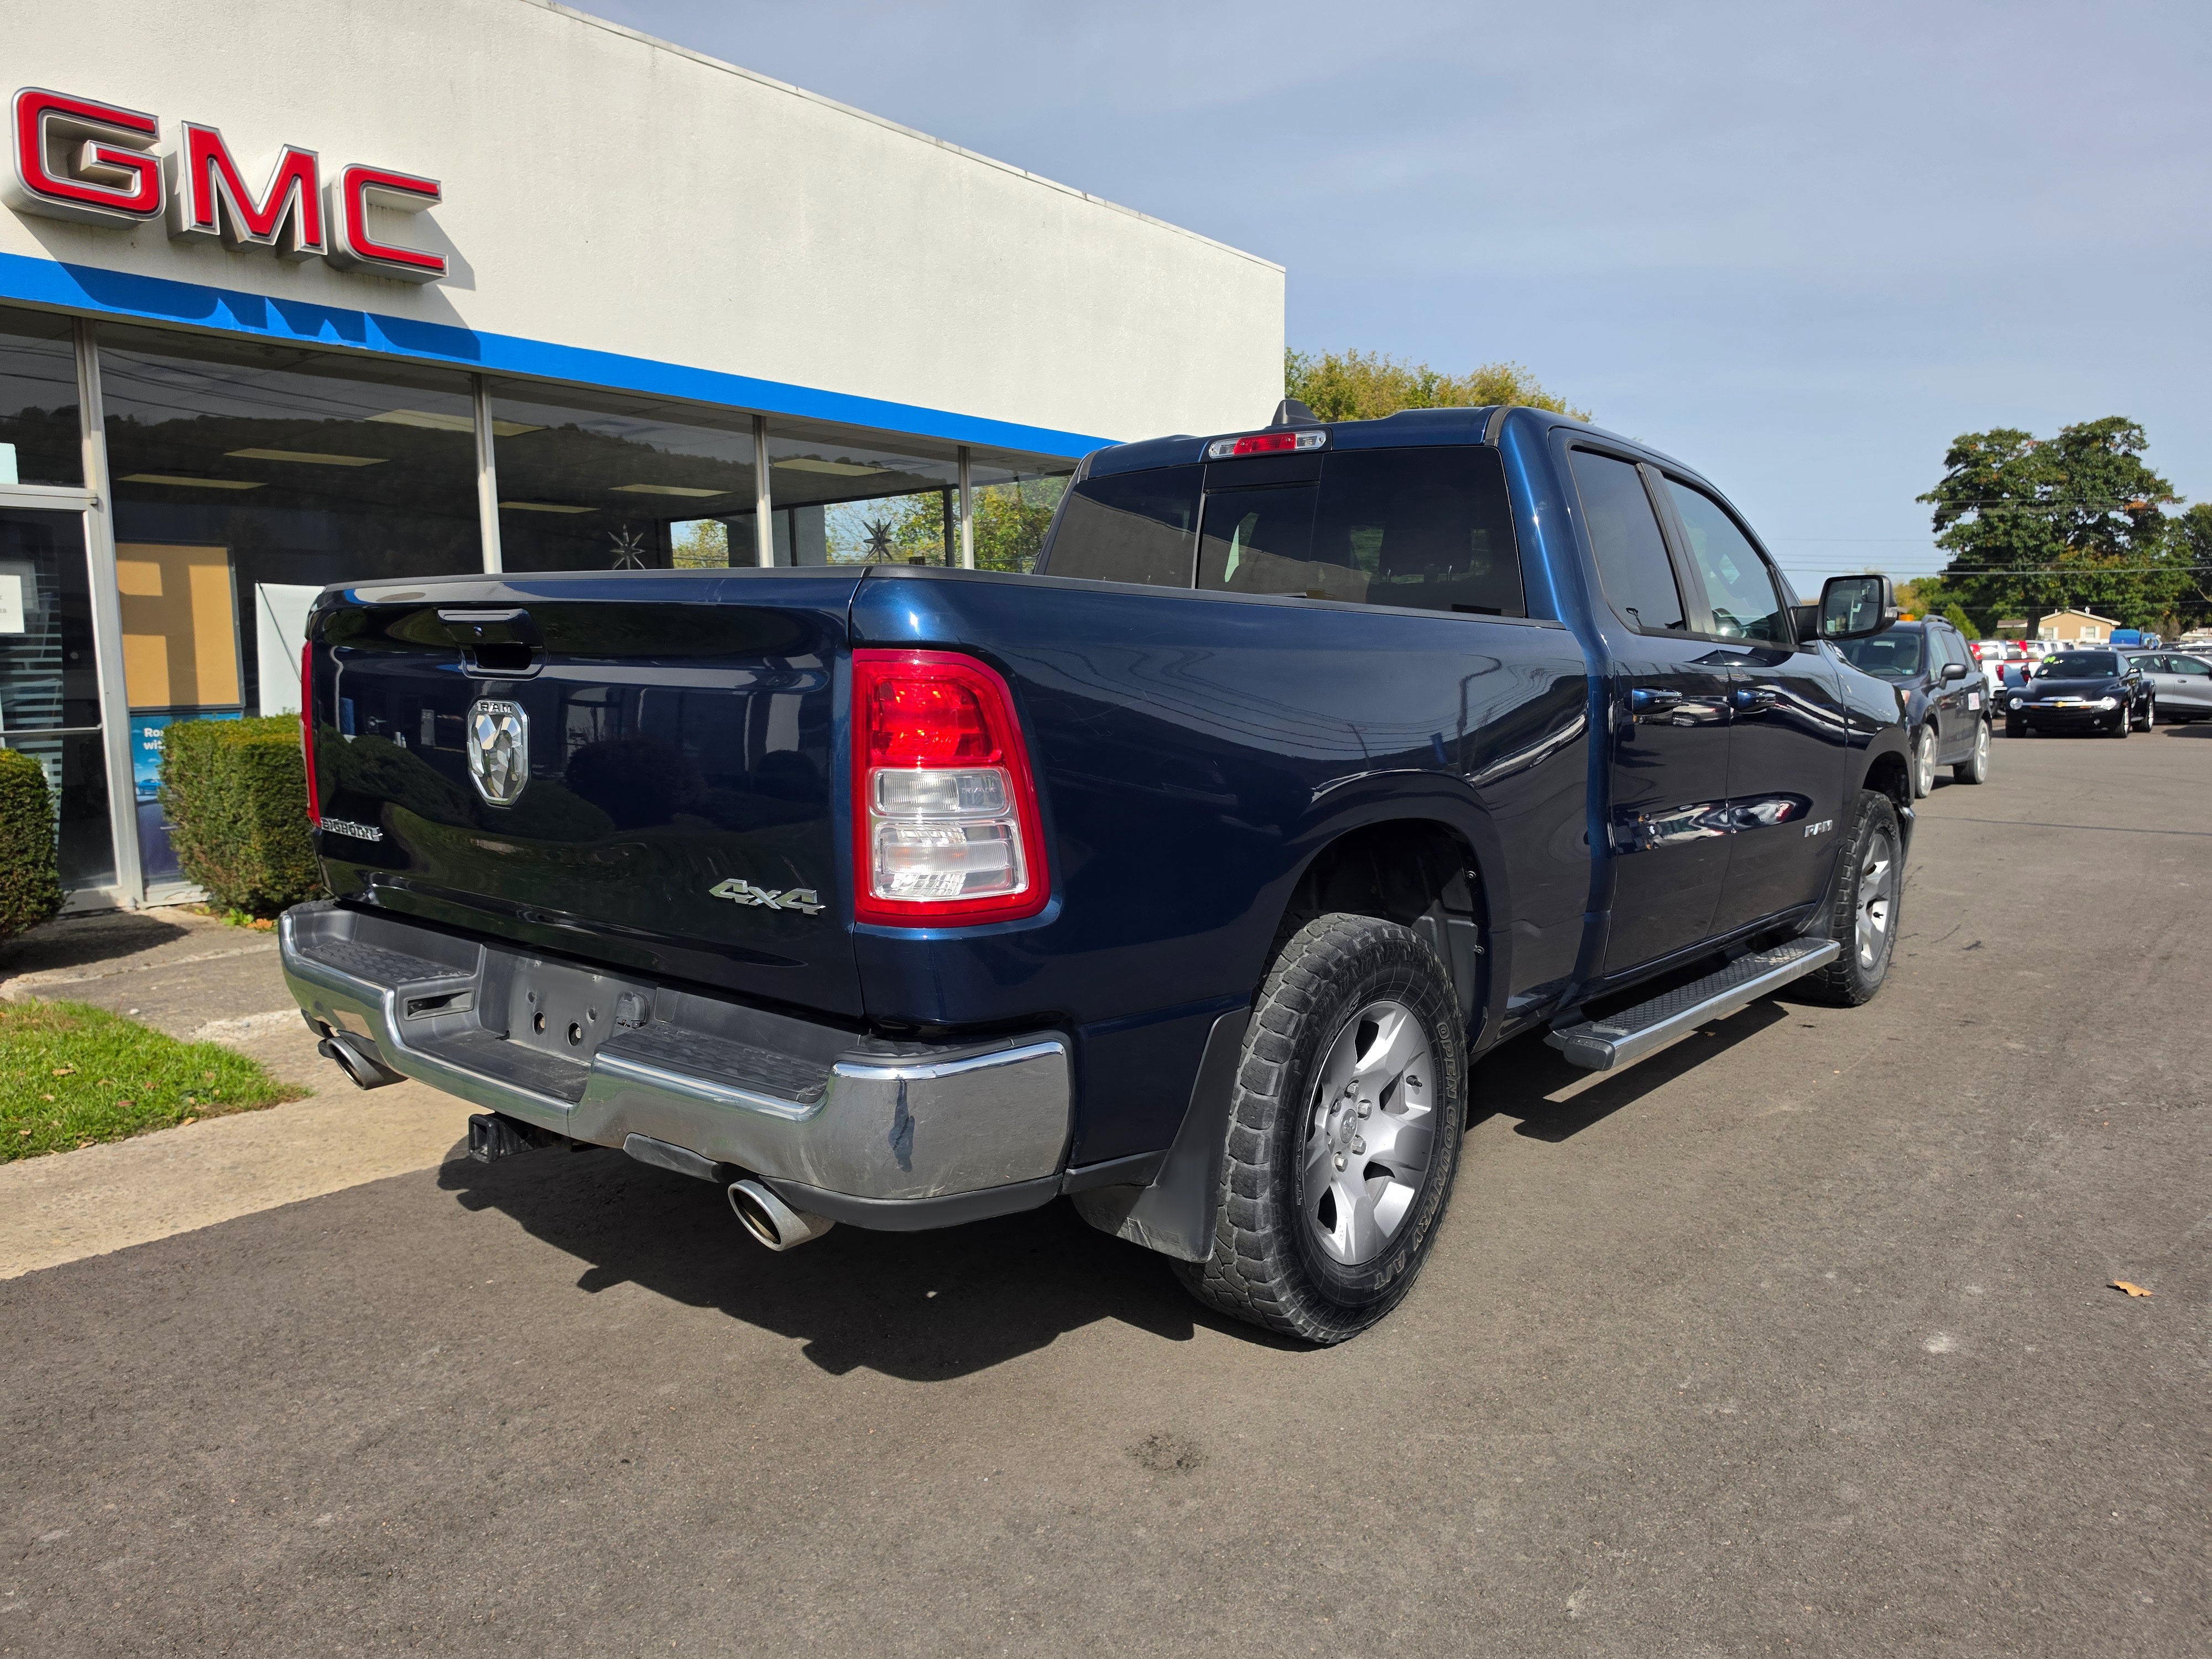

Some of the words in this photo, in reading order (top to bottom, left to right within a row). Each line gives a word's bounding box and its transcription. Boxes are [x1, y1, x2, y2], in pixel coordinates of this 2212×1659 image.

[10, 86, 449, 280] GMC
[477, 701, 512, 713] RAM
[1804, 820, 1833, 837] RAM
[1436, 1022, 1457, 1099] OPEN
[1412, 1106, 1457, 1251] COUNTRY
